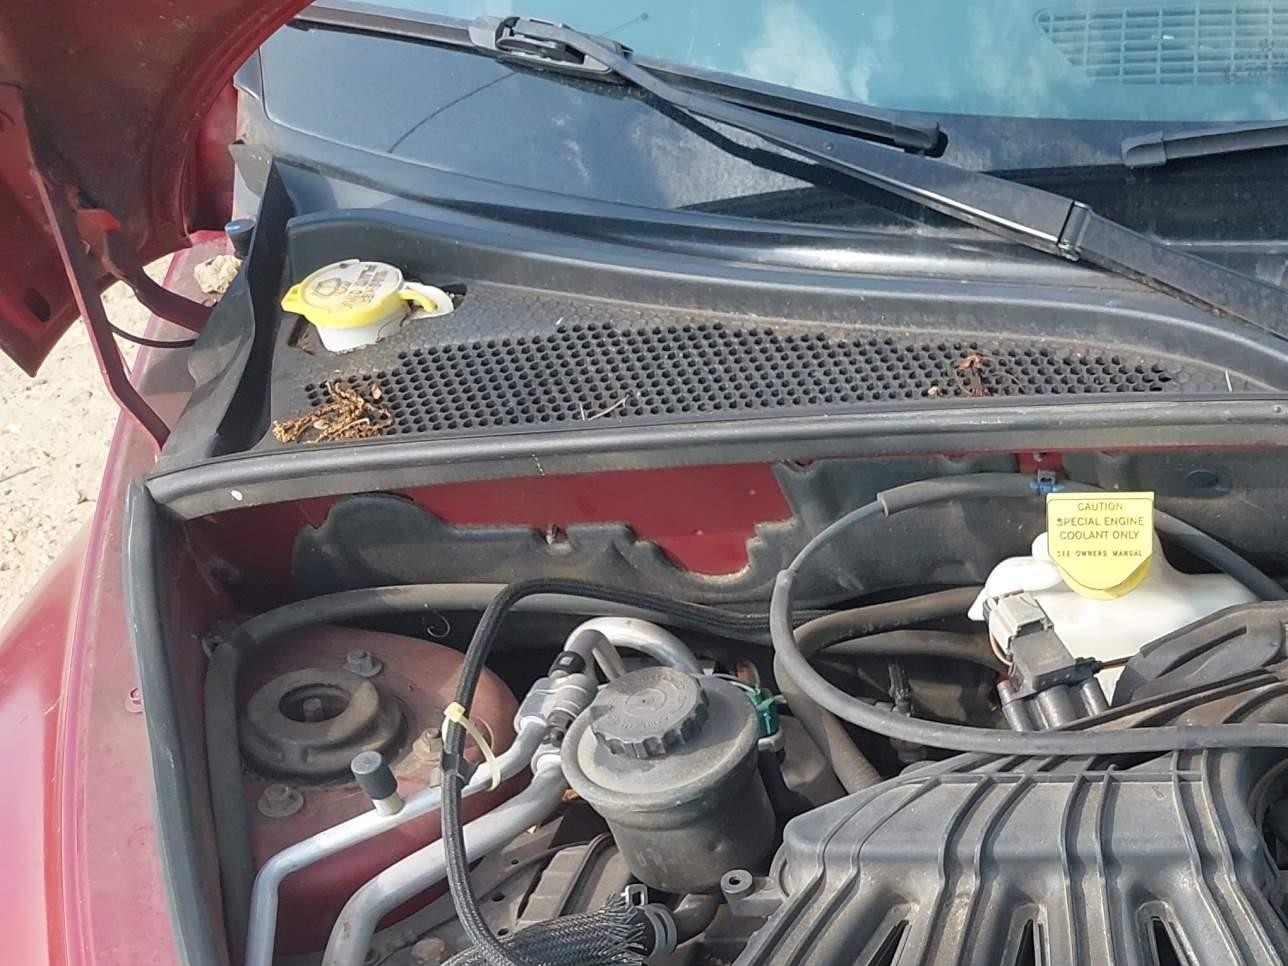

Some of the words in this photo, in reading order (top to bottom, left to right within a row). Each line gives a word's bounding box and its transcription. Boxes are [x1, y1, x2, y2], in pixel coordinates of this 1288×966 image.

[1077, 502, 1123, 511] CAUTION
[1056, 517, 1101, 526] SPECIAL
[1104, 516, 1144, 526] ENGINE
[1060, 531, 1109, 540] COOLANT
[1112, 530, 1139, 540] ONLY
